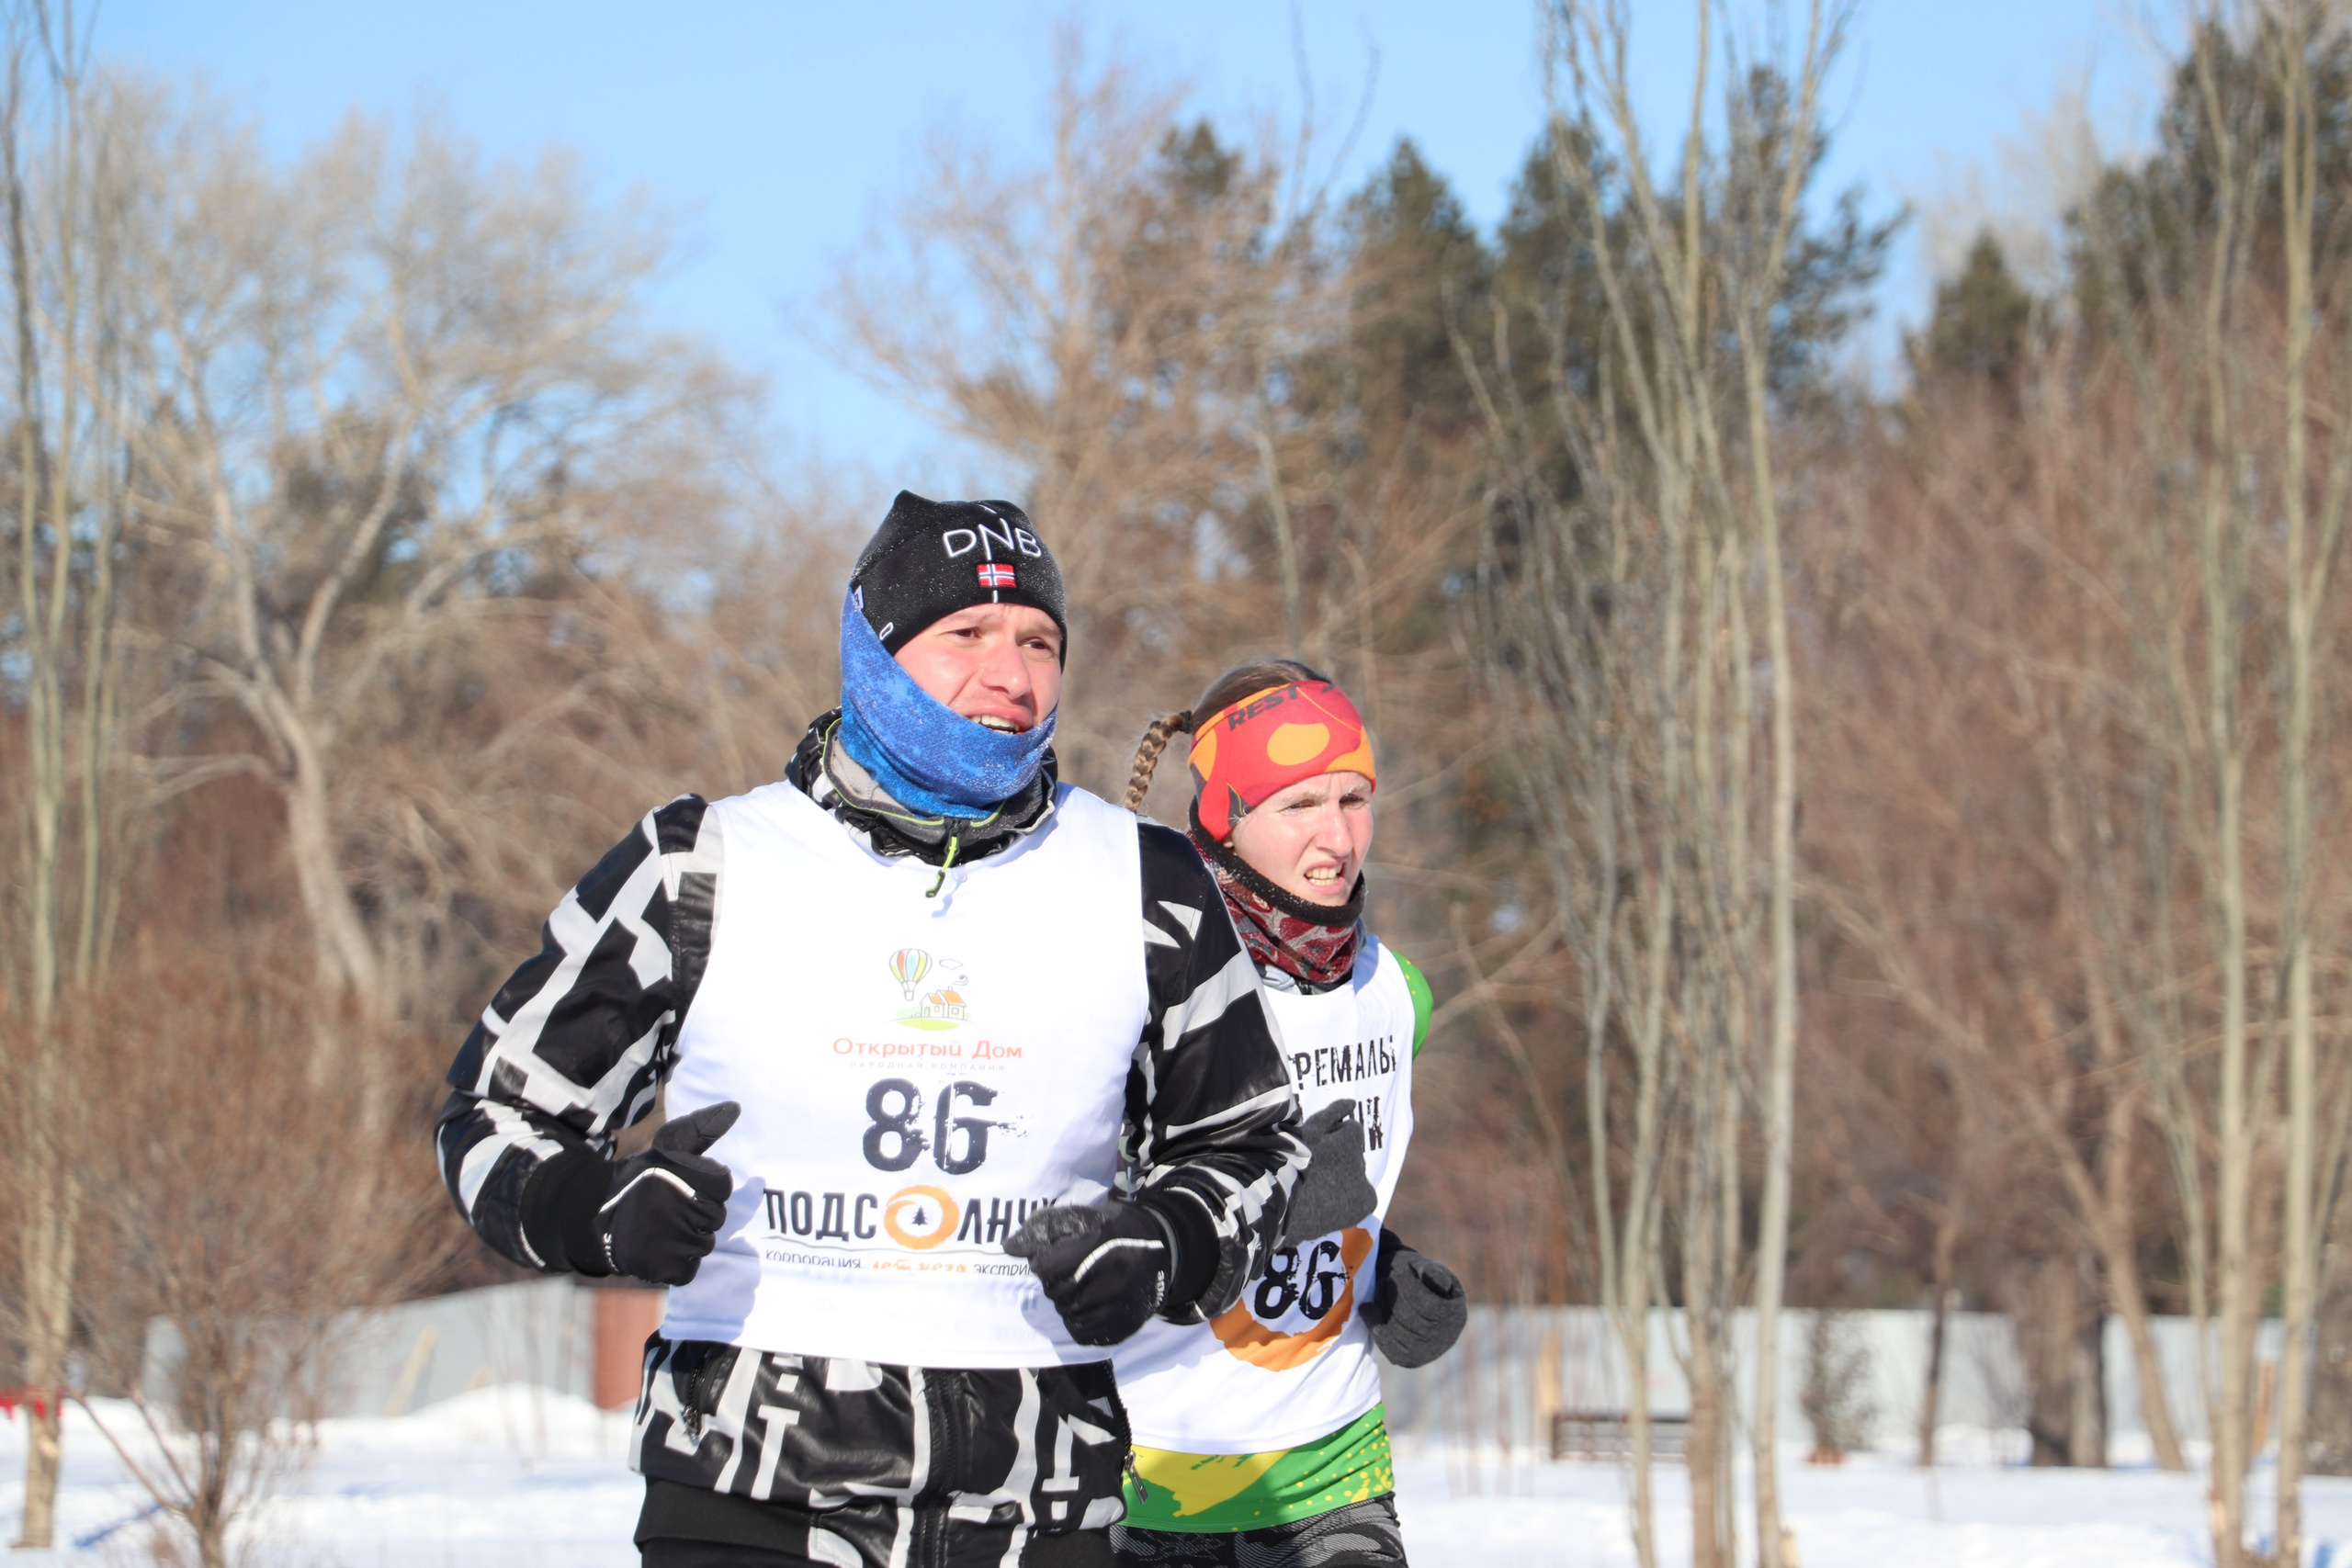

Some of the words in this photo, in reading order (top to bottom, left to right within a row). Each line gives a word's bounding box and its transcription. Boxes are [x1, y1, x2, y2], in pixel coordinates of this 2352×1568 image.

[943, 517, 1042, 561] DNB
[1227, 684, 1299, 732] REST
[832, 1037, 962, 1059] Открытый
[972, 1040, 1023, 1060] Дом
[849, 1061, 923, 1070] НАРОДНАЯ
[932, 1062, 1005, 1072] КОМПАНИЯ
[862, 1077, 1001, 1175] 86
[973, 1263, 1031, 1276] экстри
[1254, 1240, 1343, 1320] 86
